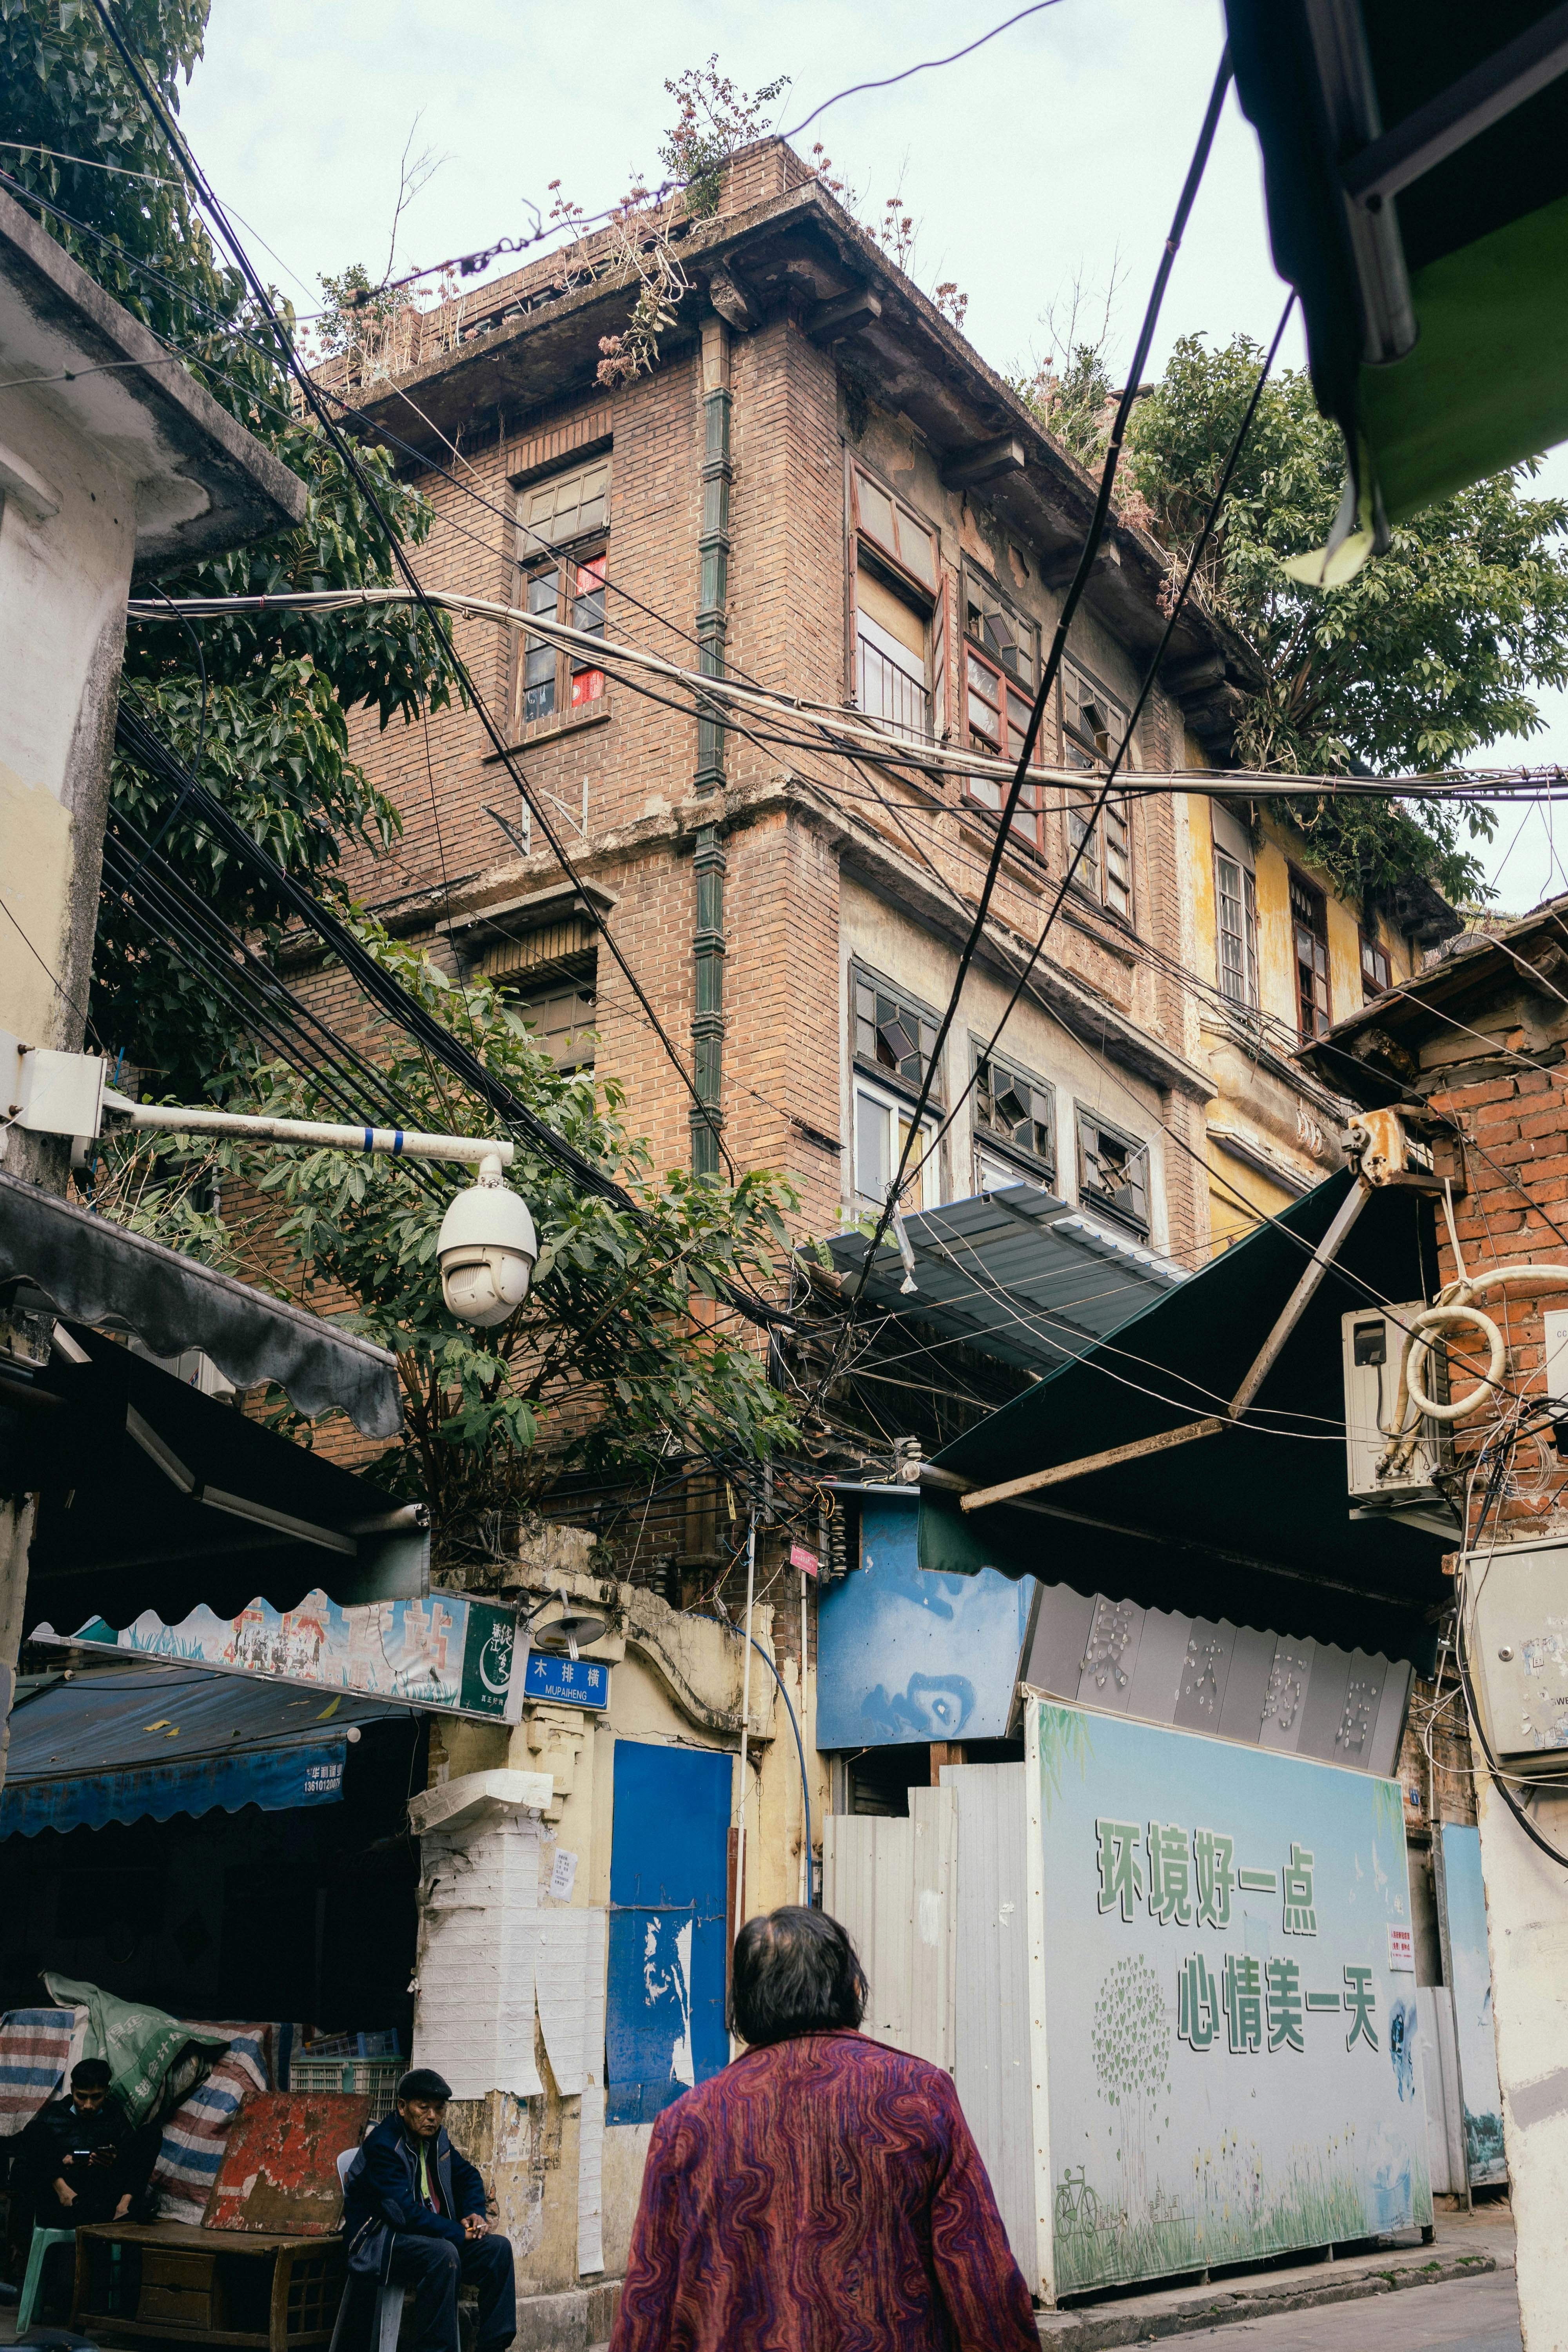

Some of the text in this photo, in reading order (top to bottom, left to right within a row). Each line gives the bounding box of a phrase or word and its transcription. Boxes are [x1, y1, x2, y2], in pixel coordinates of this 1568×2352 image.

[534, 1659, 599, 1688] 木排横
[545, 1684, 587, 1700] MUPAIHENG
[1096, 1817, 1318, 1937] 环境好一点
[1178, 1951, 1379, 2053] 心情美一天
